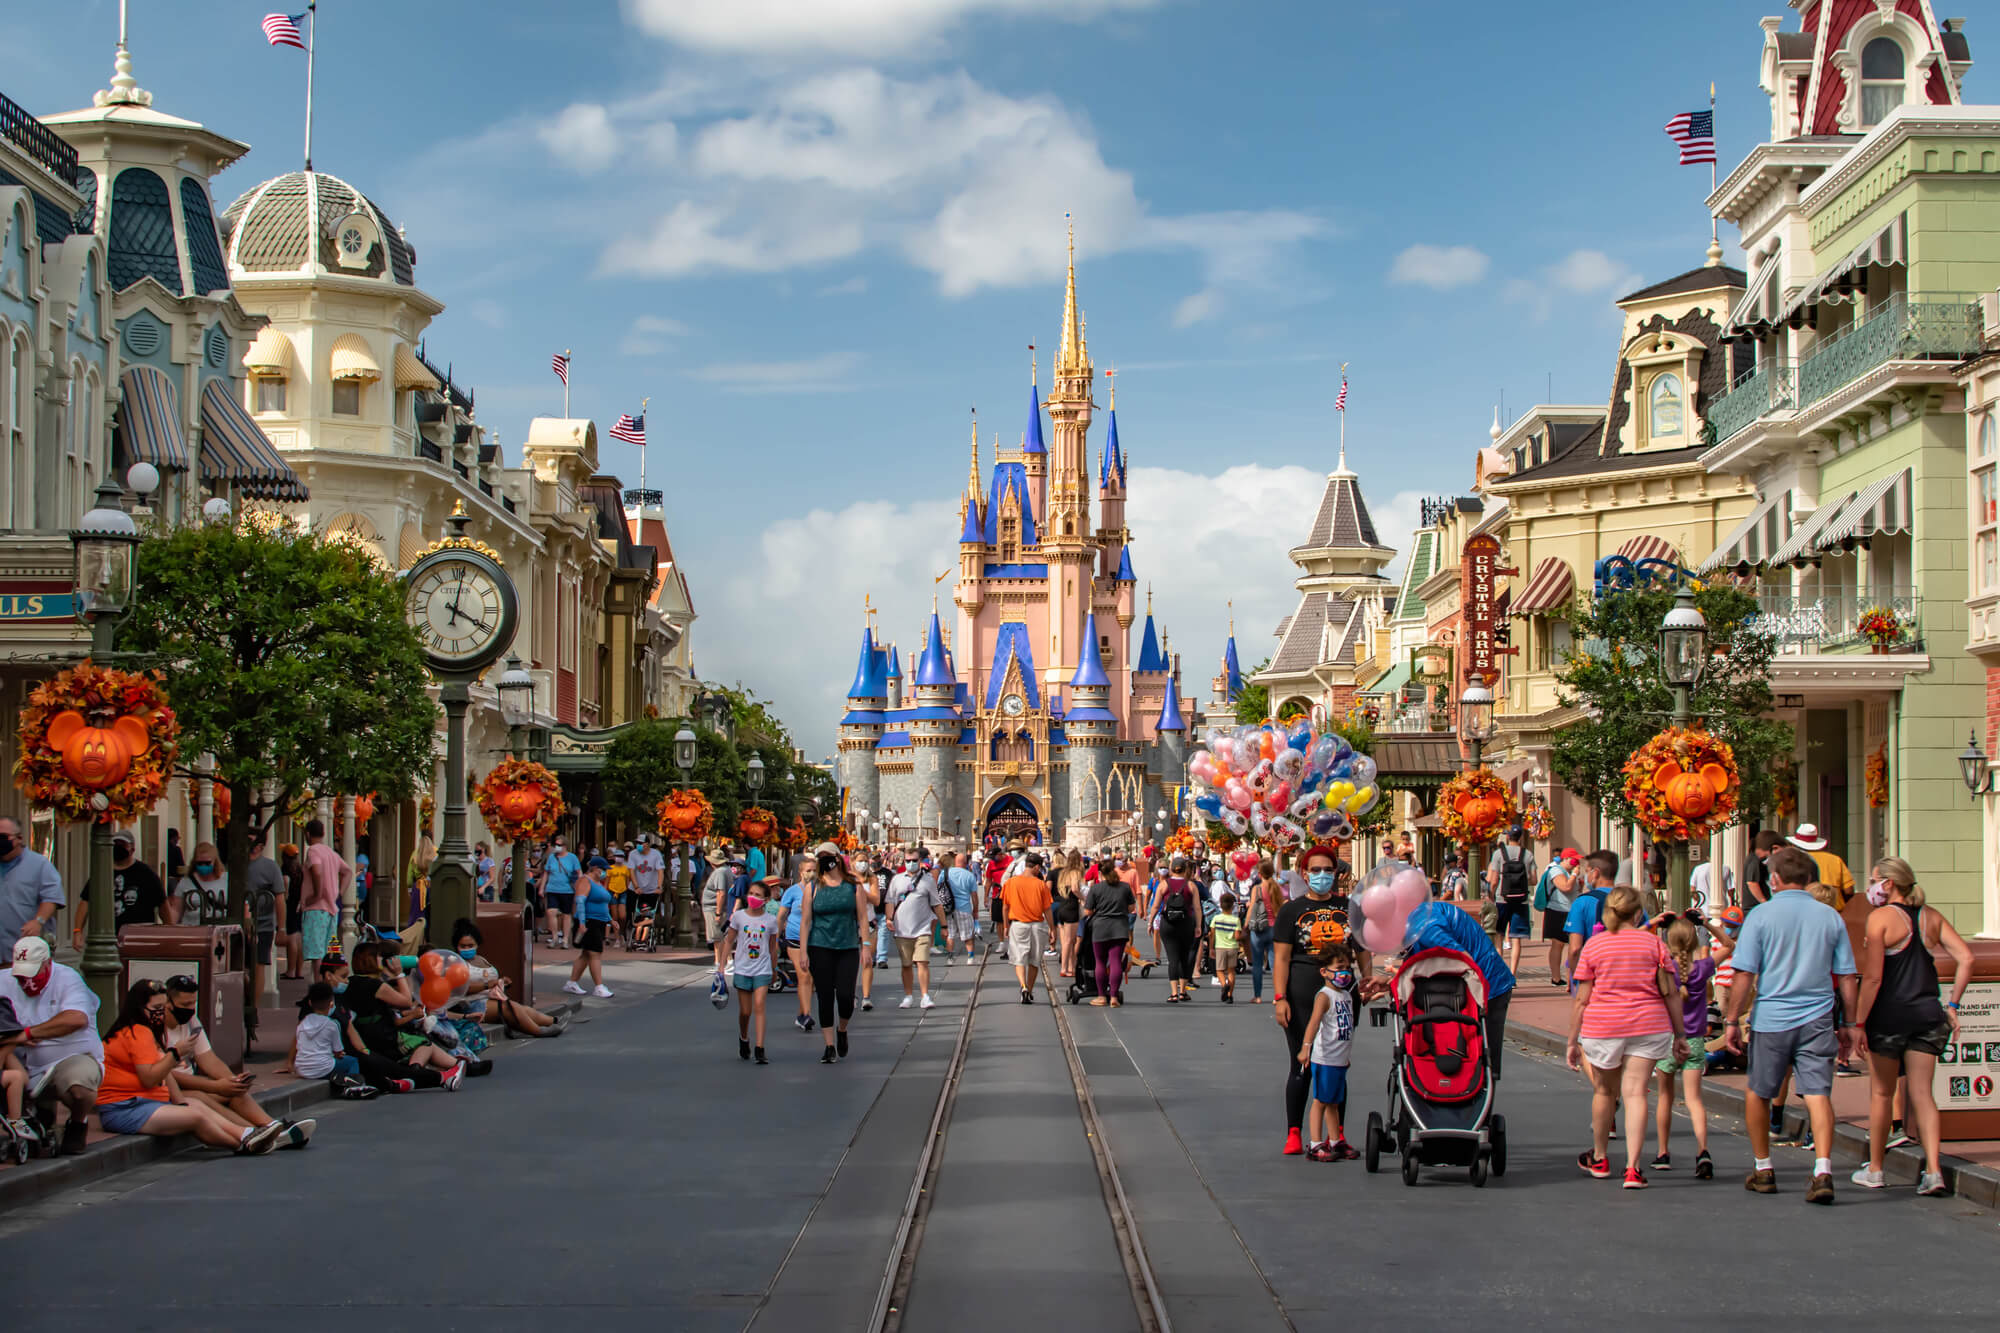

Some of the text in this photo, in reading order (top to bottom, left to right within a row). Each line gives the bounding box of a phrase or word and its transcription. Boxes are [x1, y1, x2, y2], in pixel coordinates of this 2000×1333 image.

[0, 596, 43, 615] LLS
[1475, 555, 1489, 668] CRYSTAL ARTS
